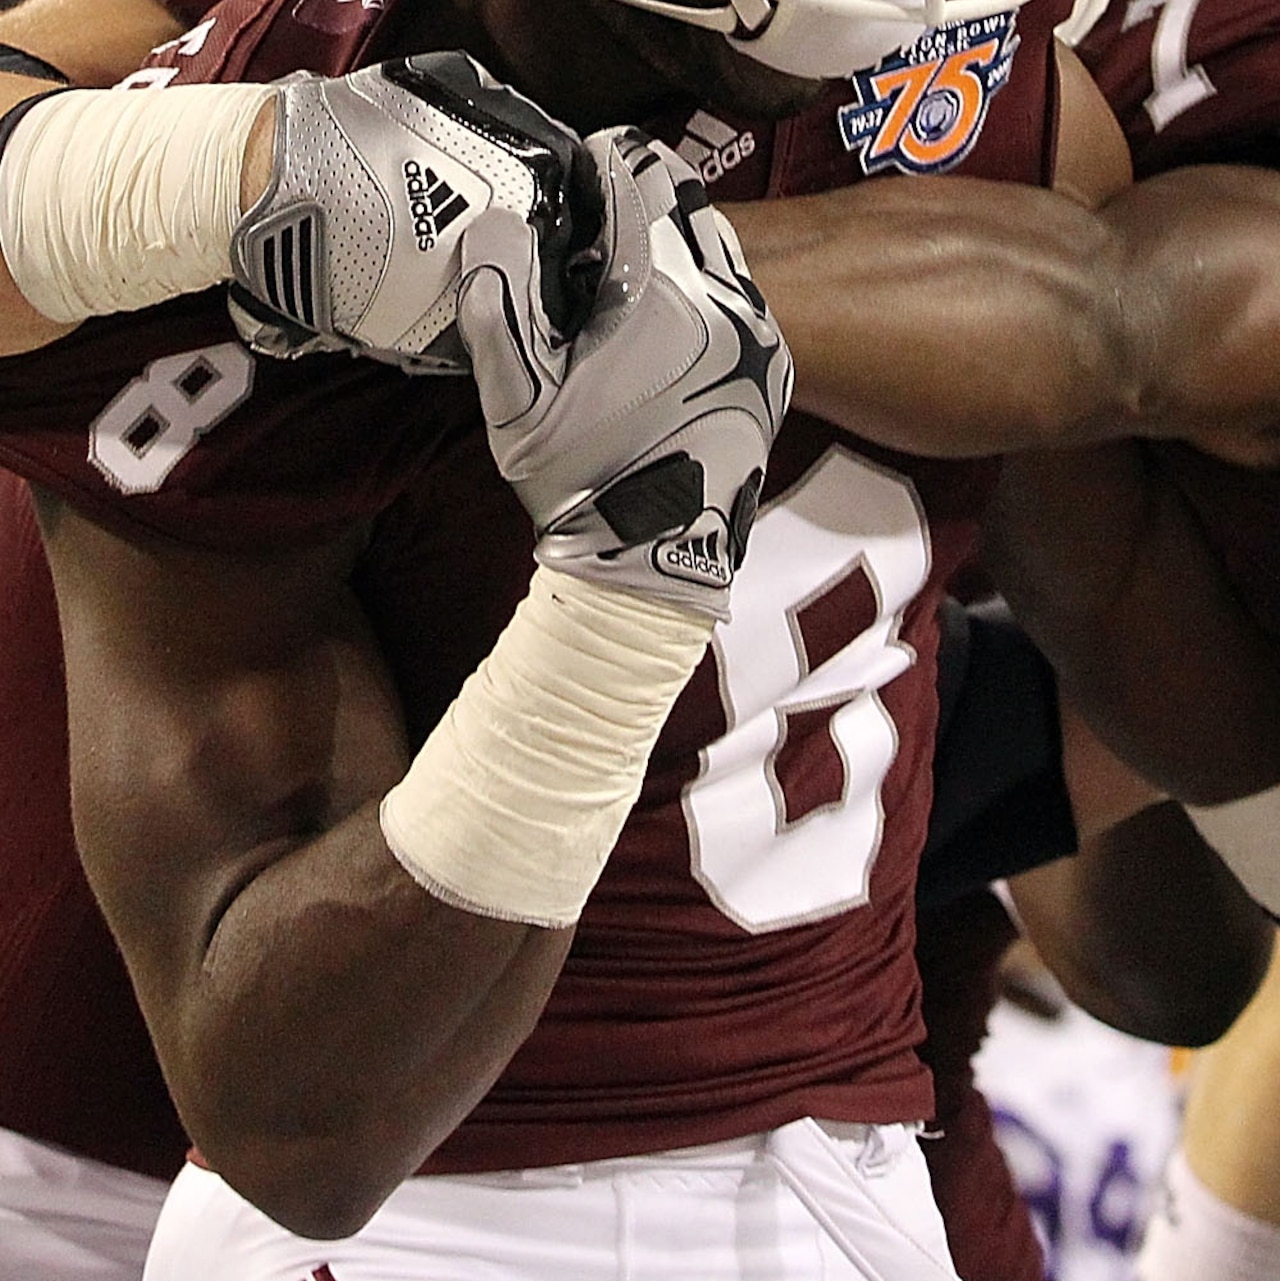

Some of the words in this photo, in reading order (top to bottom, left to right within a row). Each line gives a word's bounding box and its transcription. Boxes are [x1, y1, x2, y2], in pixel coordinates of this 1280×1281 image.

[869, 37, 1000, 165] 75
[403, 160, 435, 252] adidas
[88, 340, 255, 495] 8
[666, 550, 727, 582] adidas
[680, 441, 933, 936] 8
